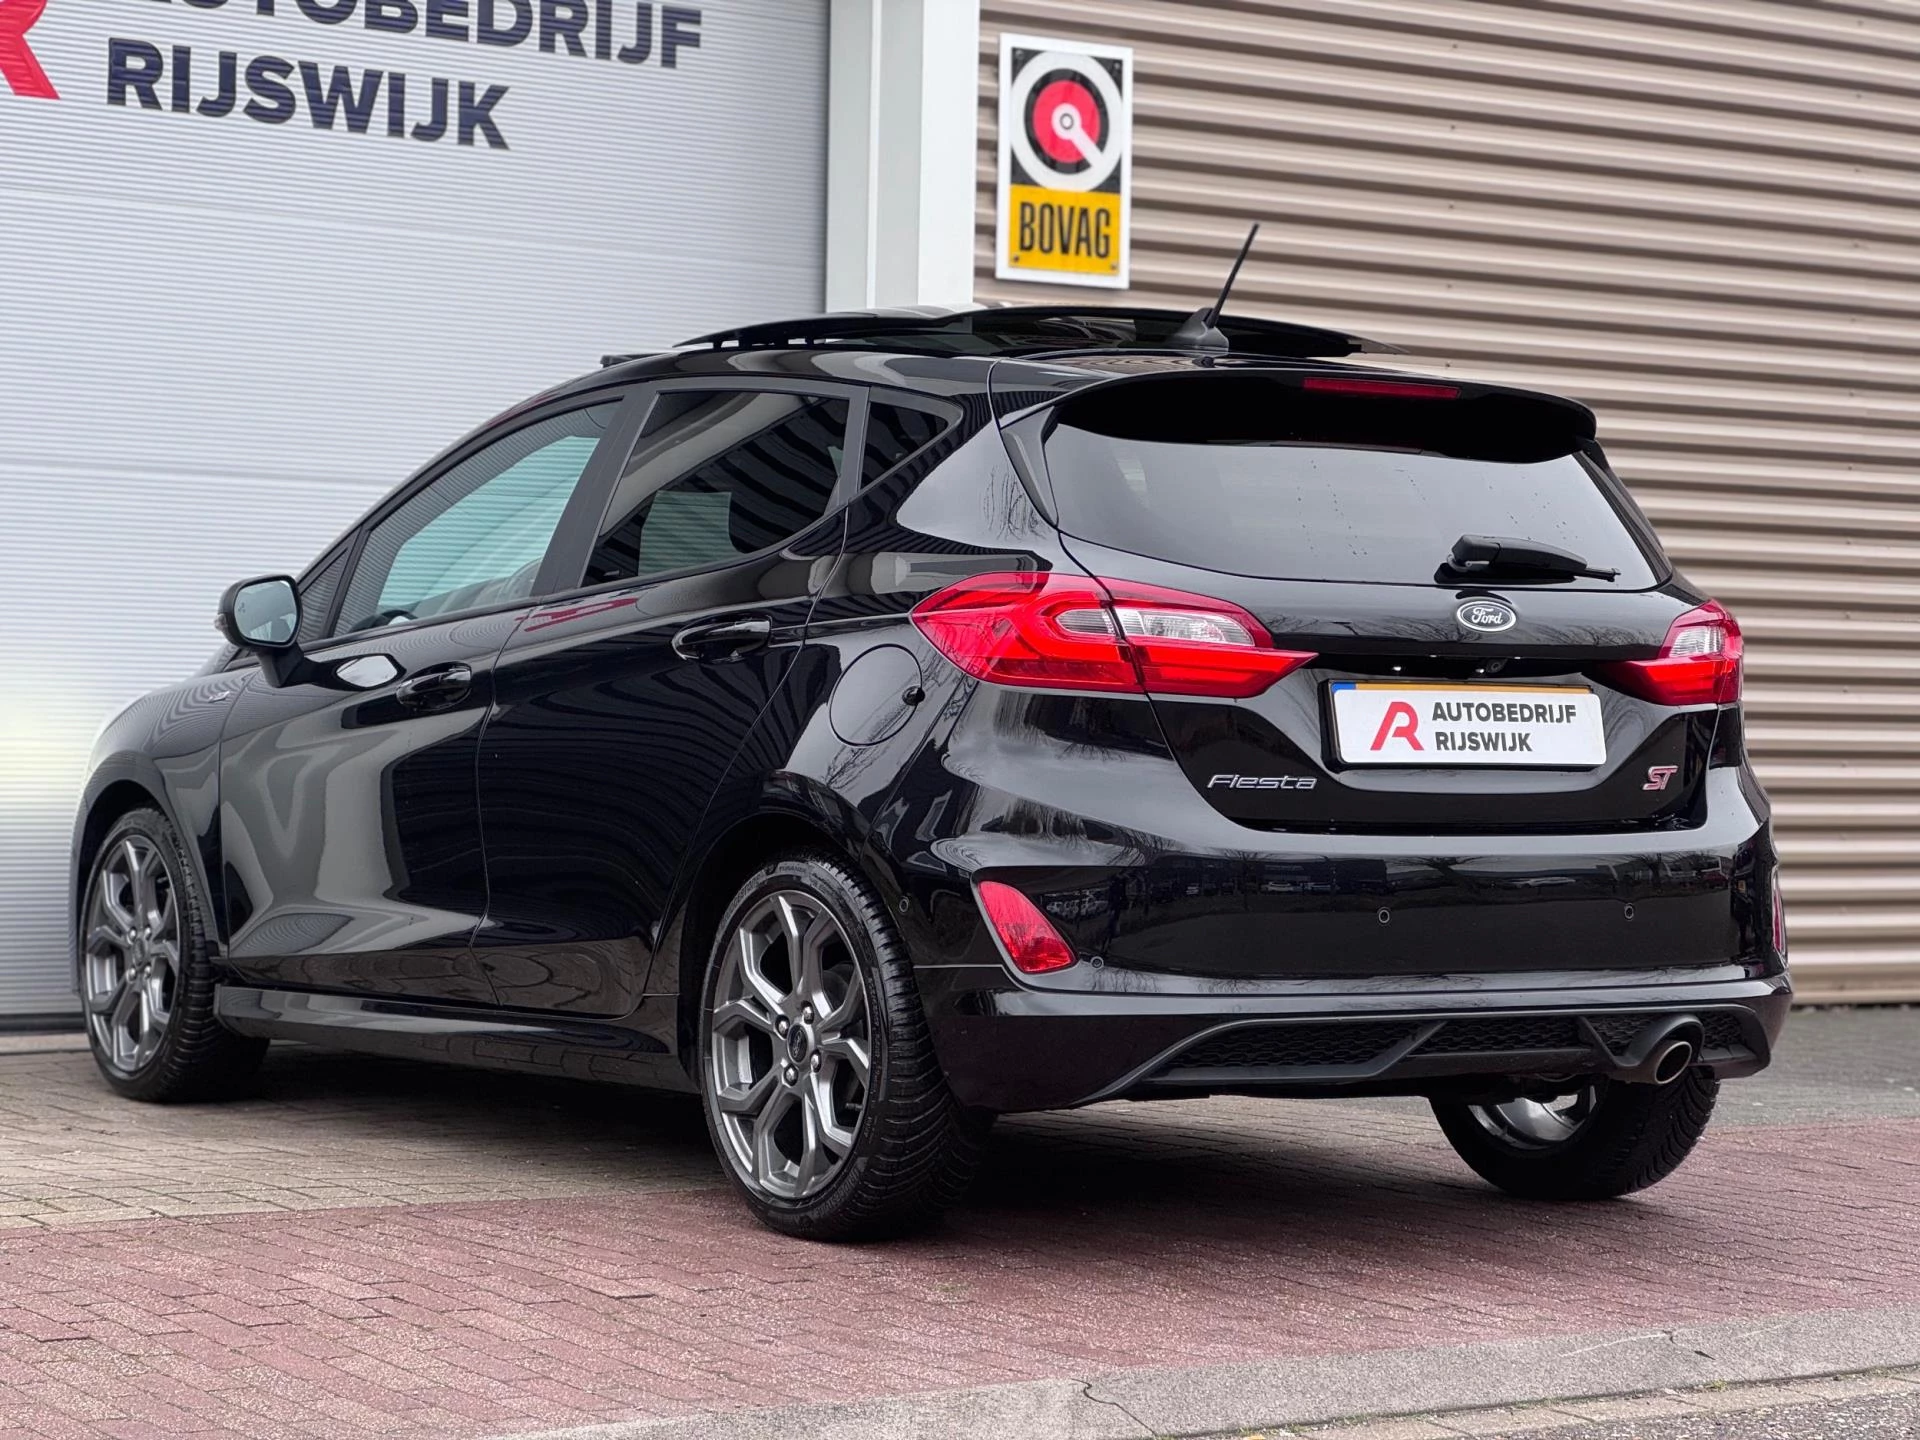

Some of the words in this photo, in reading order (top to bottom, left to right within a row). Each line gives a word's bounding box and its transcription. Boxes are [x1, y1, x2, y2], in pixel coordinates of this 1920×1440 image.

[150, 0, 702, 69] EDRIJF
[106, 37, 510, 150] RIJSWIJK
[1019, 201, 1111, 259] BOVAG
[1471, 606, 1504, 624] Ford
[1432, 702, 1577, 723] AUTOBEDRIJF
[1435, 731, 1533, 752] RIJSWIJK
[1206, 774, 1318, 790] Fiesta
[1642, 765, 1679, 790] ST
